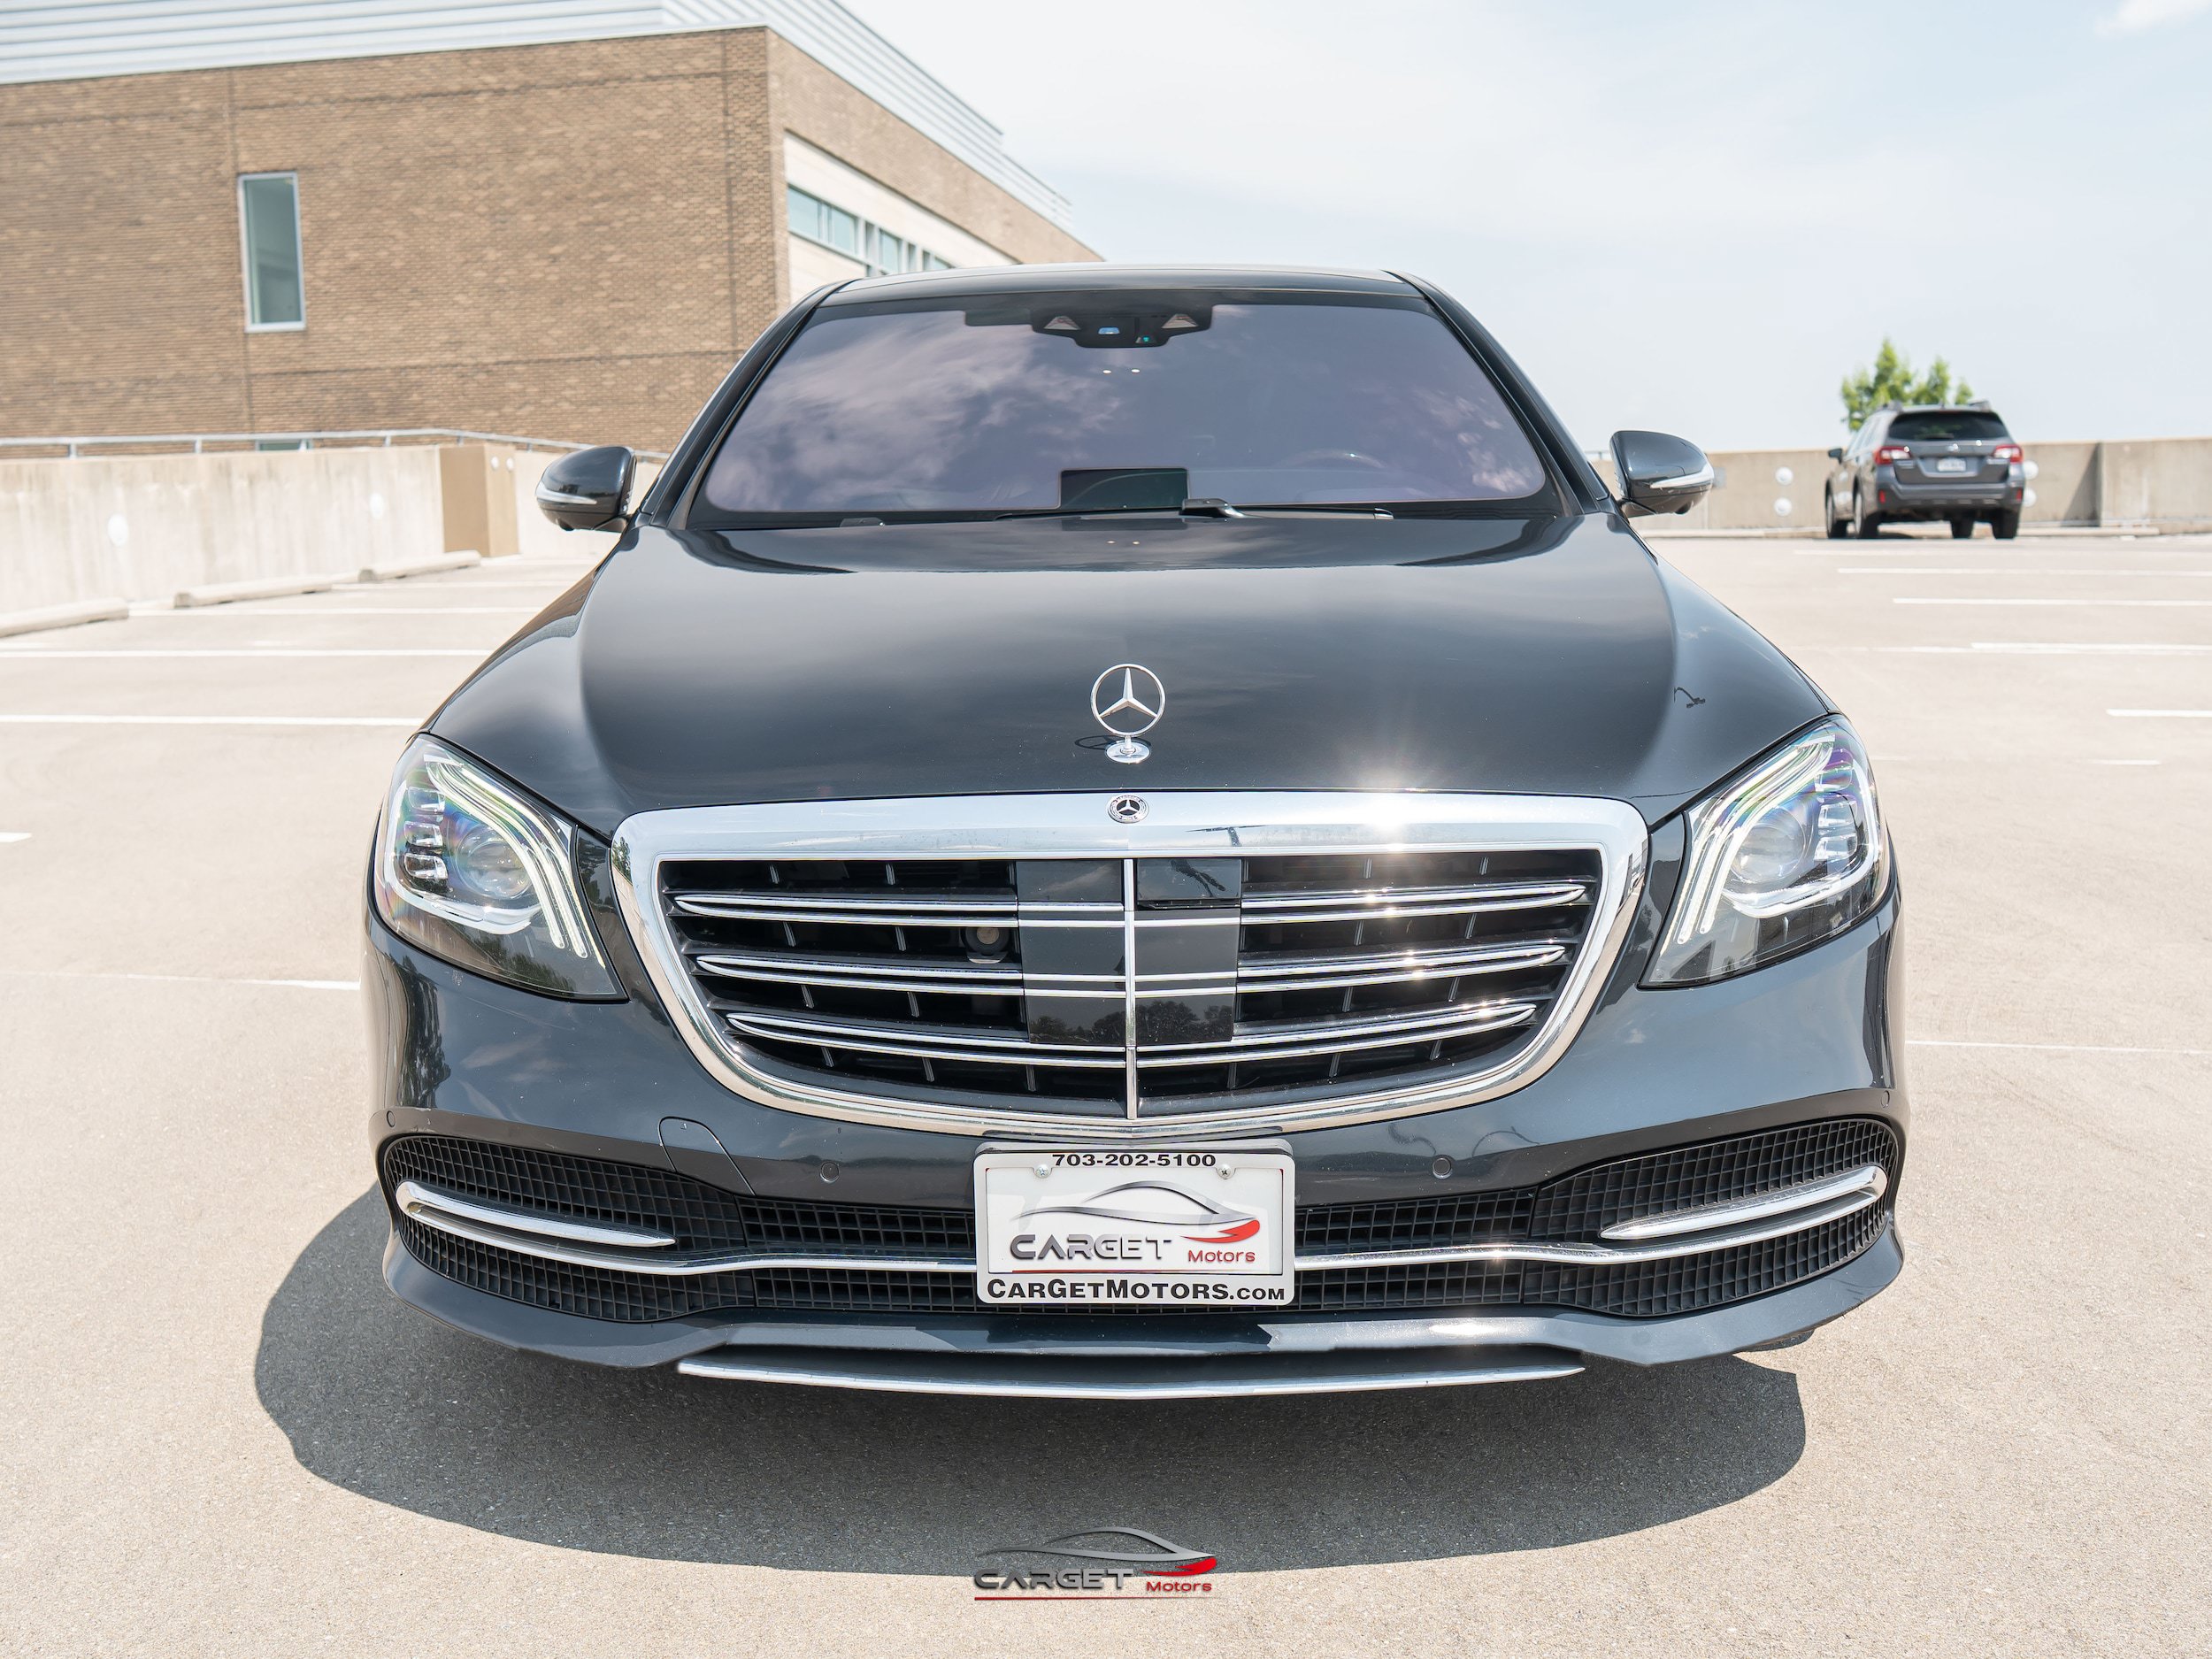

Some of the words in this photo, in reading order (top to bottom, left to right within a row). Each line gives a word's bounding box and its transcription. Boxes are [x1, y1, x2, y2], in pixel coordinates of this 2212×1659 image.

[1052, 1154, 1217, 1166] 703-202-5100
[1010, 1234, 1171, 1260] CARGET
[1187, 1249, 1256, 1263] Motors
